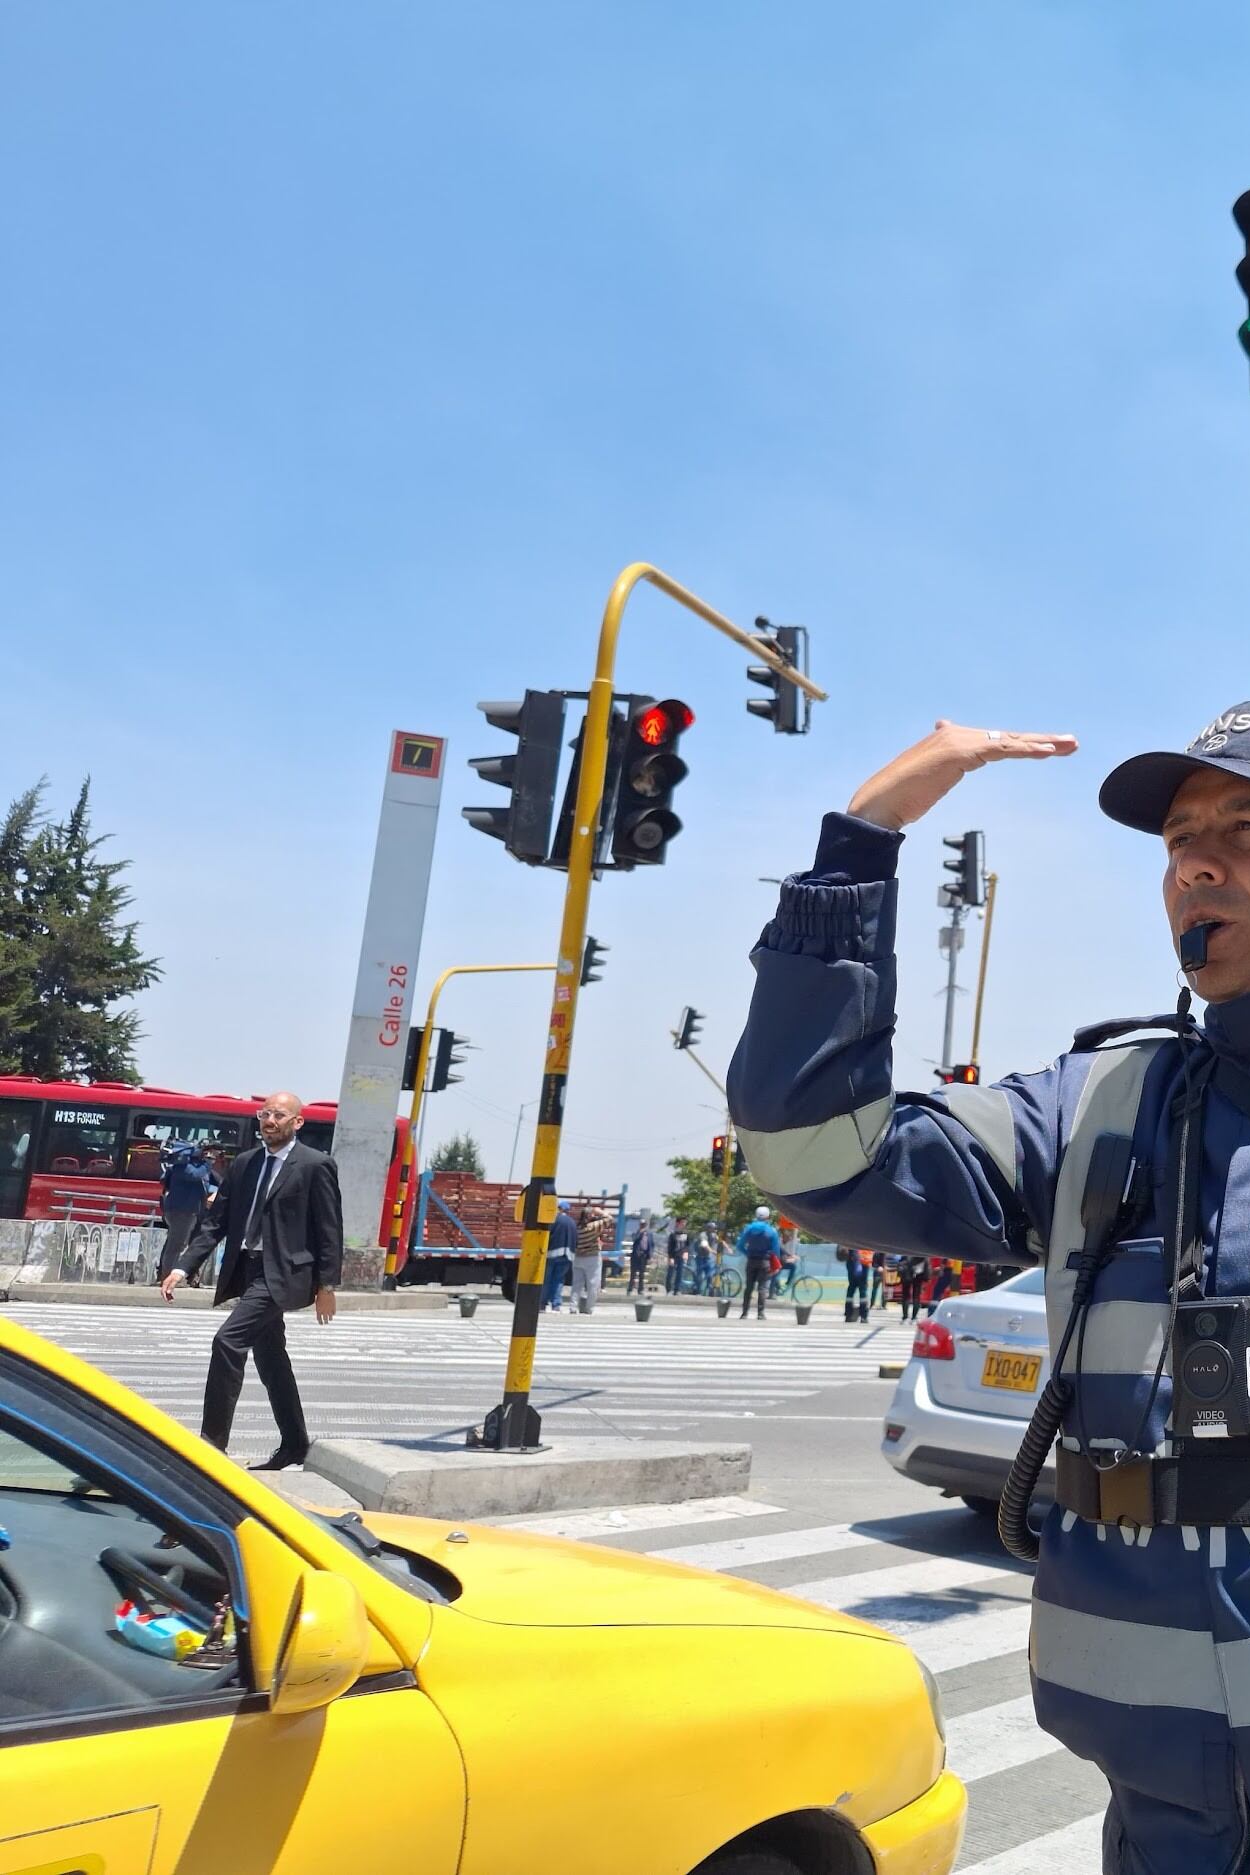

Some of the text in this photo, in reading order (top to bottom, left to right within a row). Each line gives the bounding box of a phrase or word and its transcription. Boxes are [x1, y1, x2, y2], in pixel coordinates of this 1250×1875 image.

[379, 965, 407, 1046] Calle 26
[55, 1110, 76, 1123] H13
[1192, 1363, 1219, 1373] HALO
[1196, 1410, 1225, 1420] VIDEO
